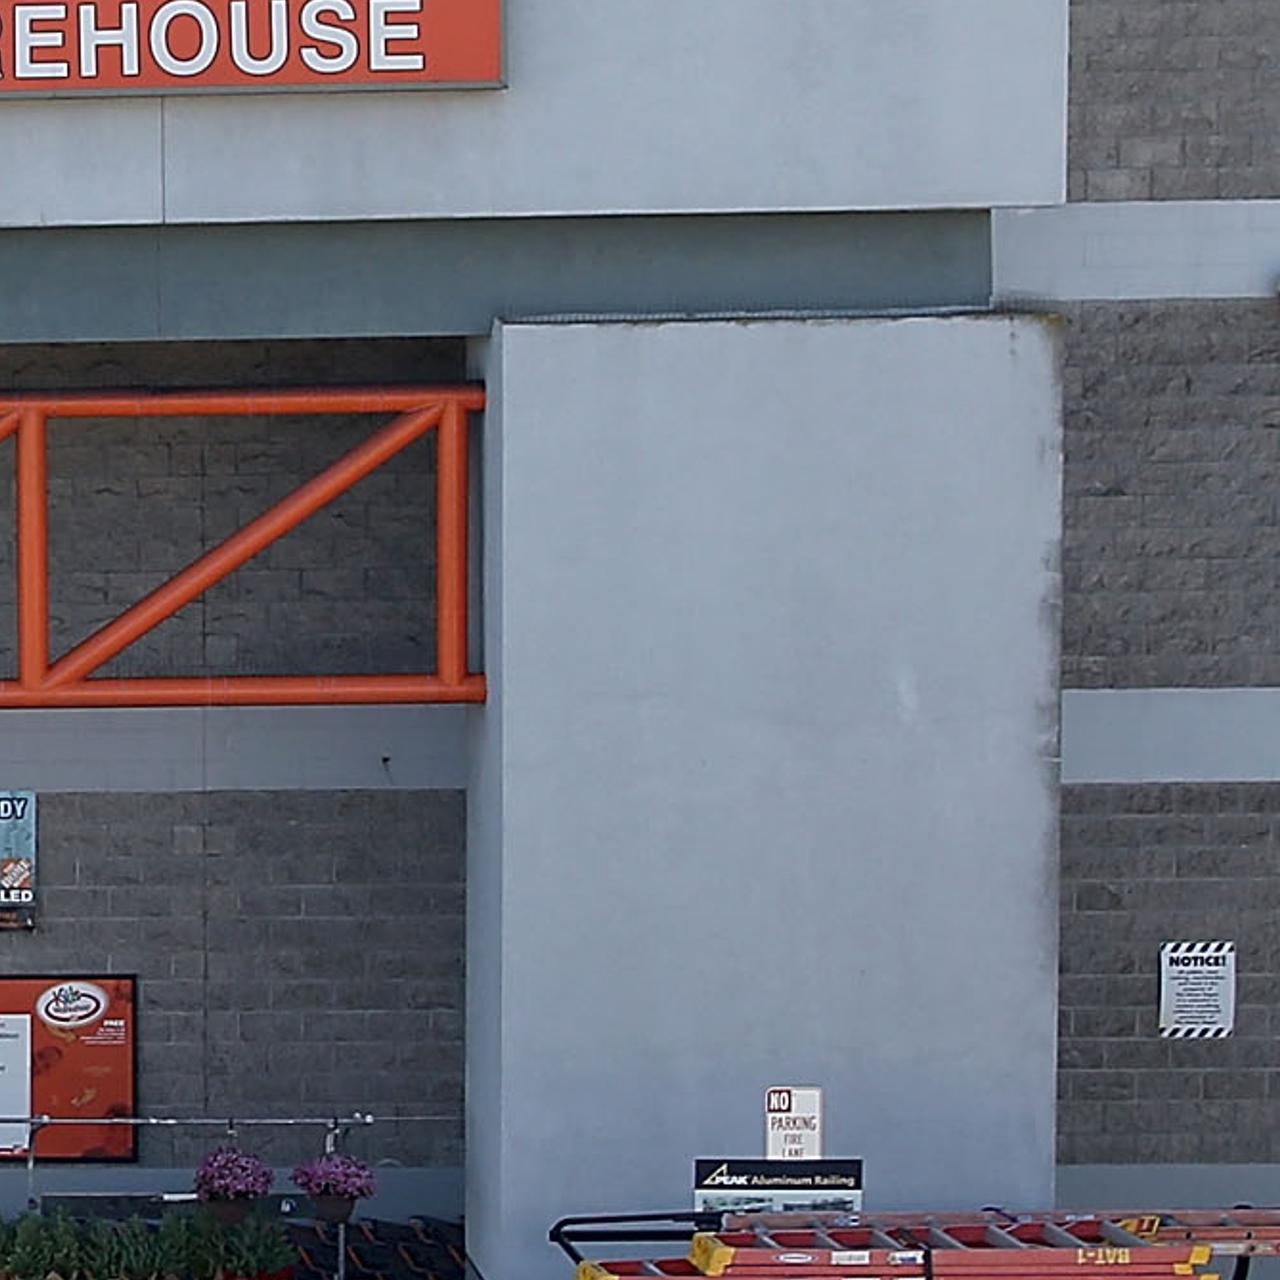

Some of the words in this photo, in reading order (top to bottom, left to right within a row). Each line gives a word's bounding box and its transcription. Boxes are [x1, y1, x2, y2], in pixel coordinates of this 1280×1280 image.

[1168, 955, 1226, 967] NOTICE!
[769, 1091, 789, 1111] NO
[770, 1115, 817, 1131] PARKING
[751, 1174, 813, 1186] Aluminum
[814, 1175, 857, 1187] Railing
[1077, 1247, 1131, 1265] BAT-1
